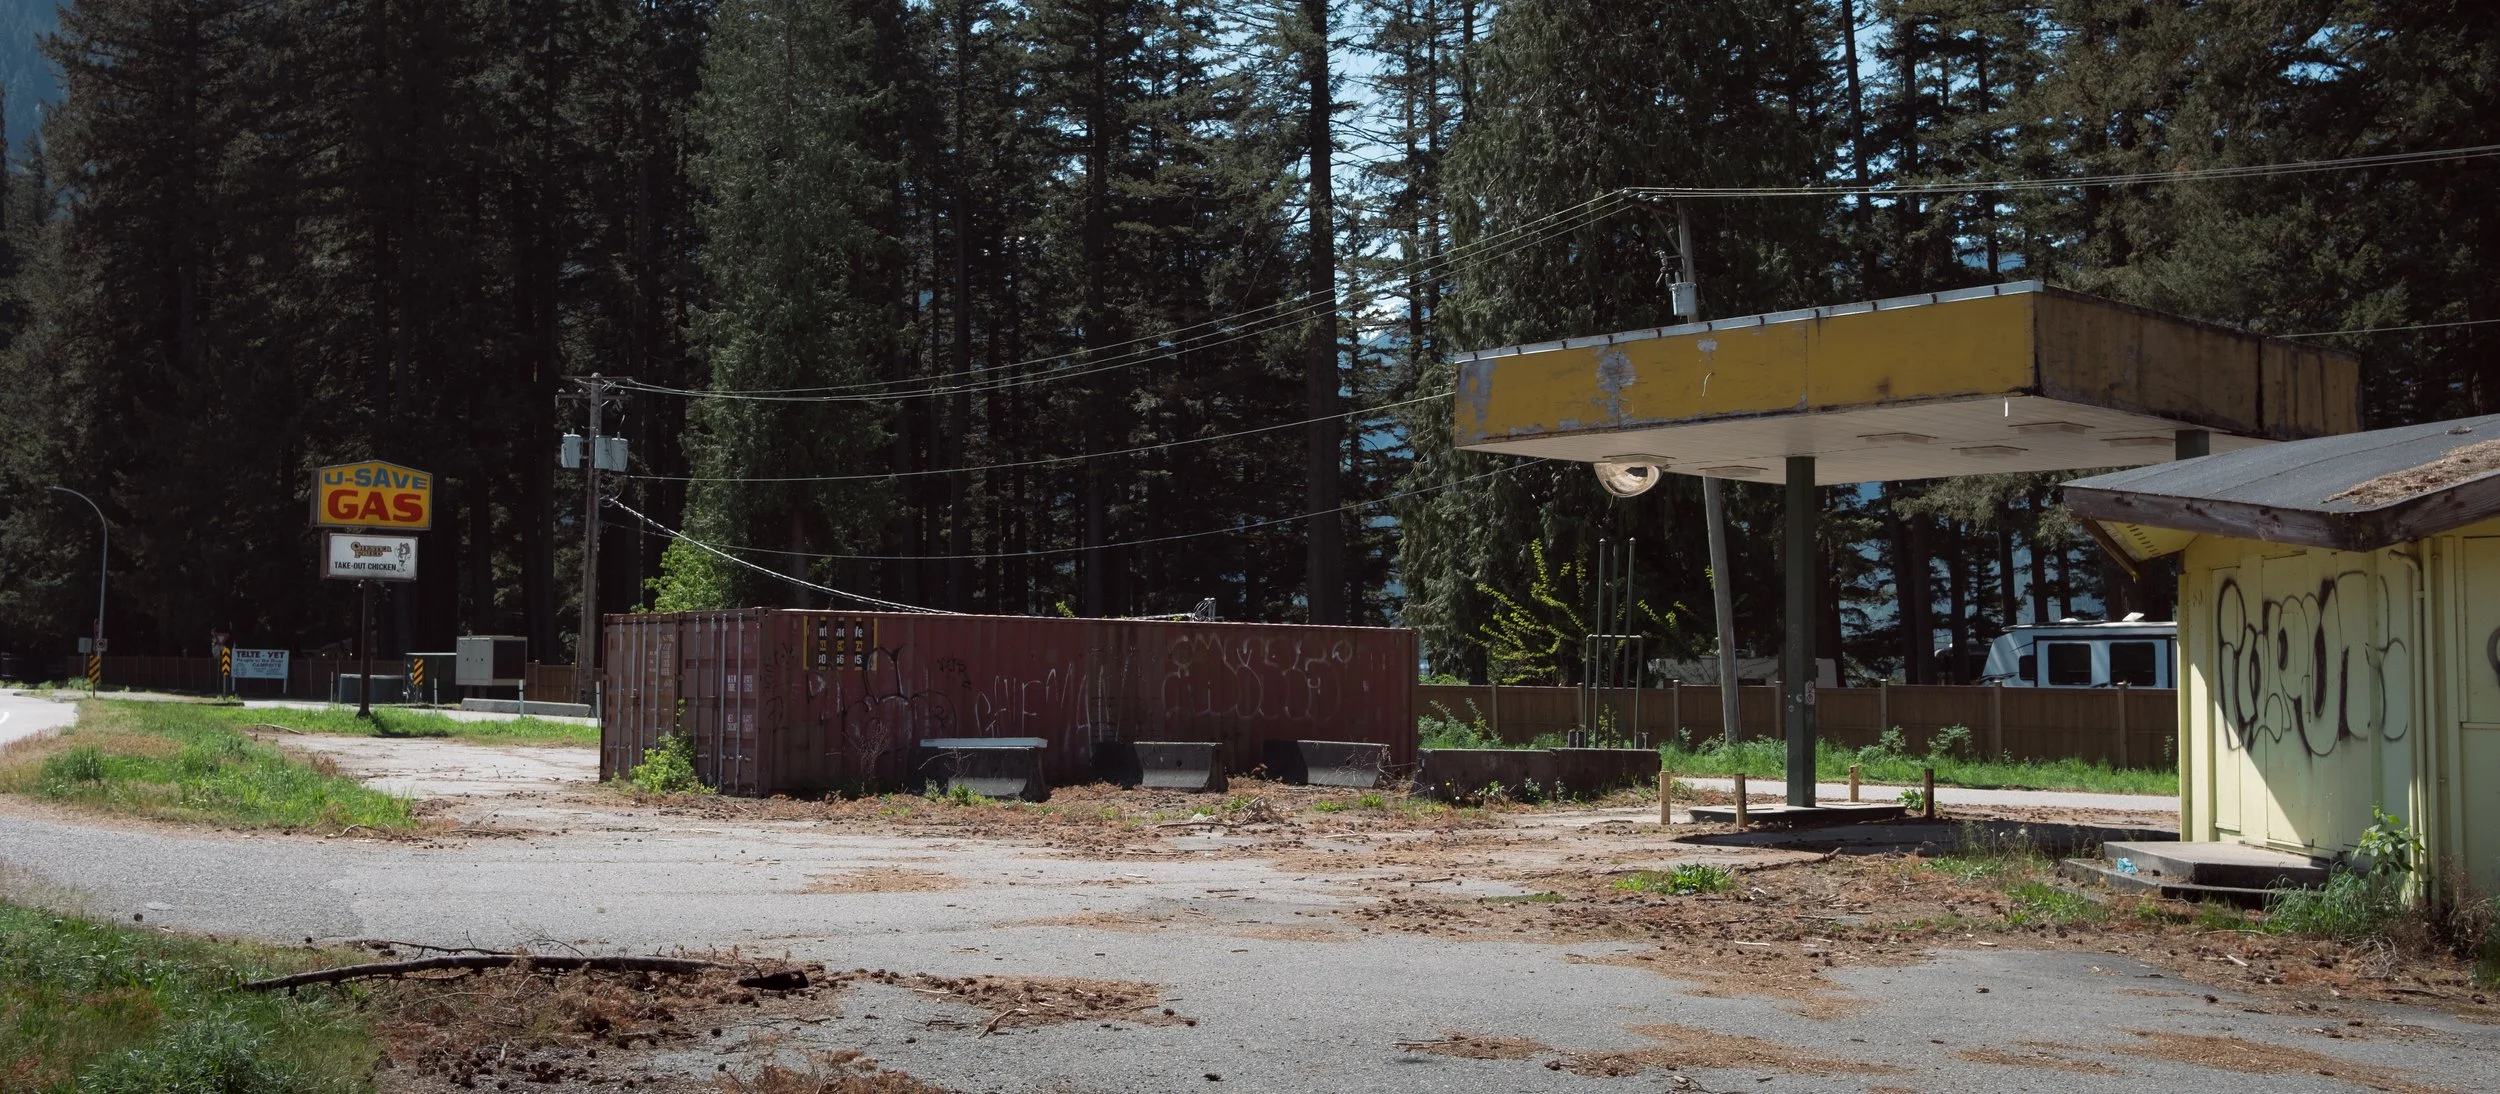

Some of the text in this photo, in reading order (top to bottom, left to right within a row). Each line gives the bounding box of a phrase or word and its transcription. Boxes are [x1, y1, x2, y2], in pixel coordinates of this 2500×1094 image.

[325, 468, 427, 489] U-SAVE
[327, 489, 424, 523] GAS
[334, 561, 397, 571] TAKE-OUT CHICKEN
